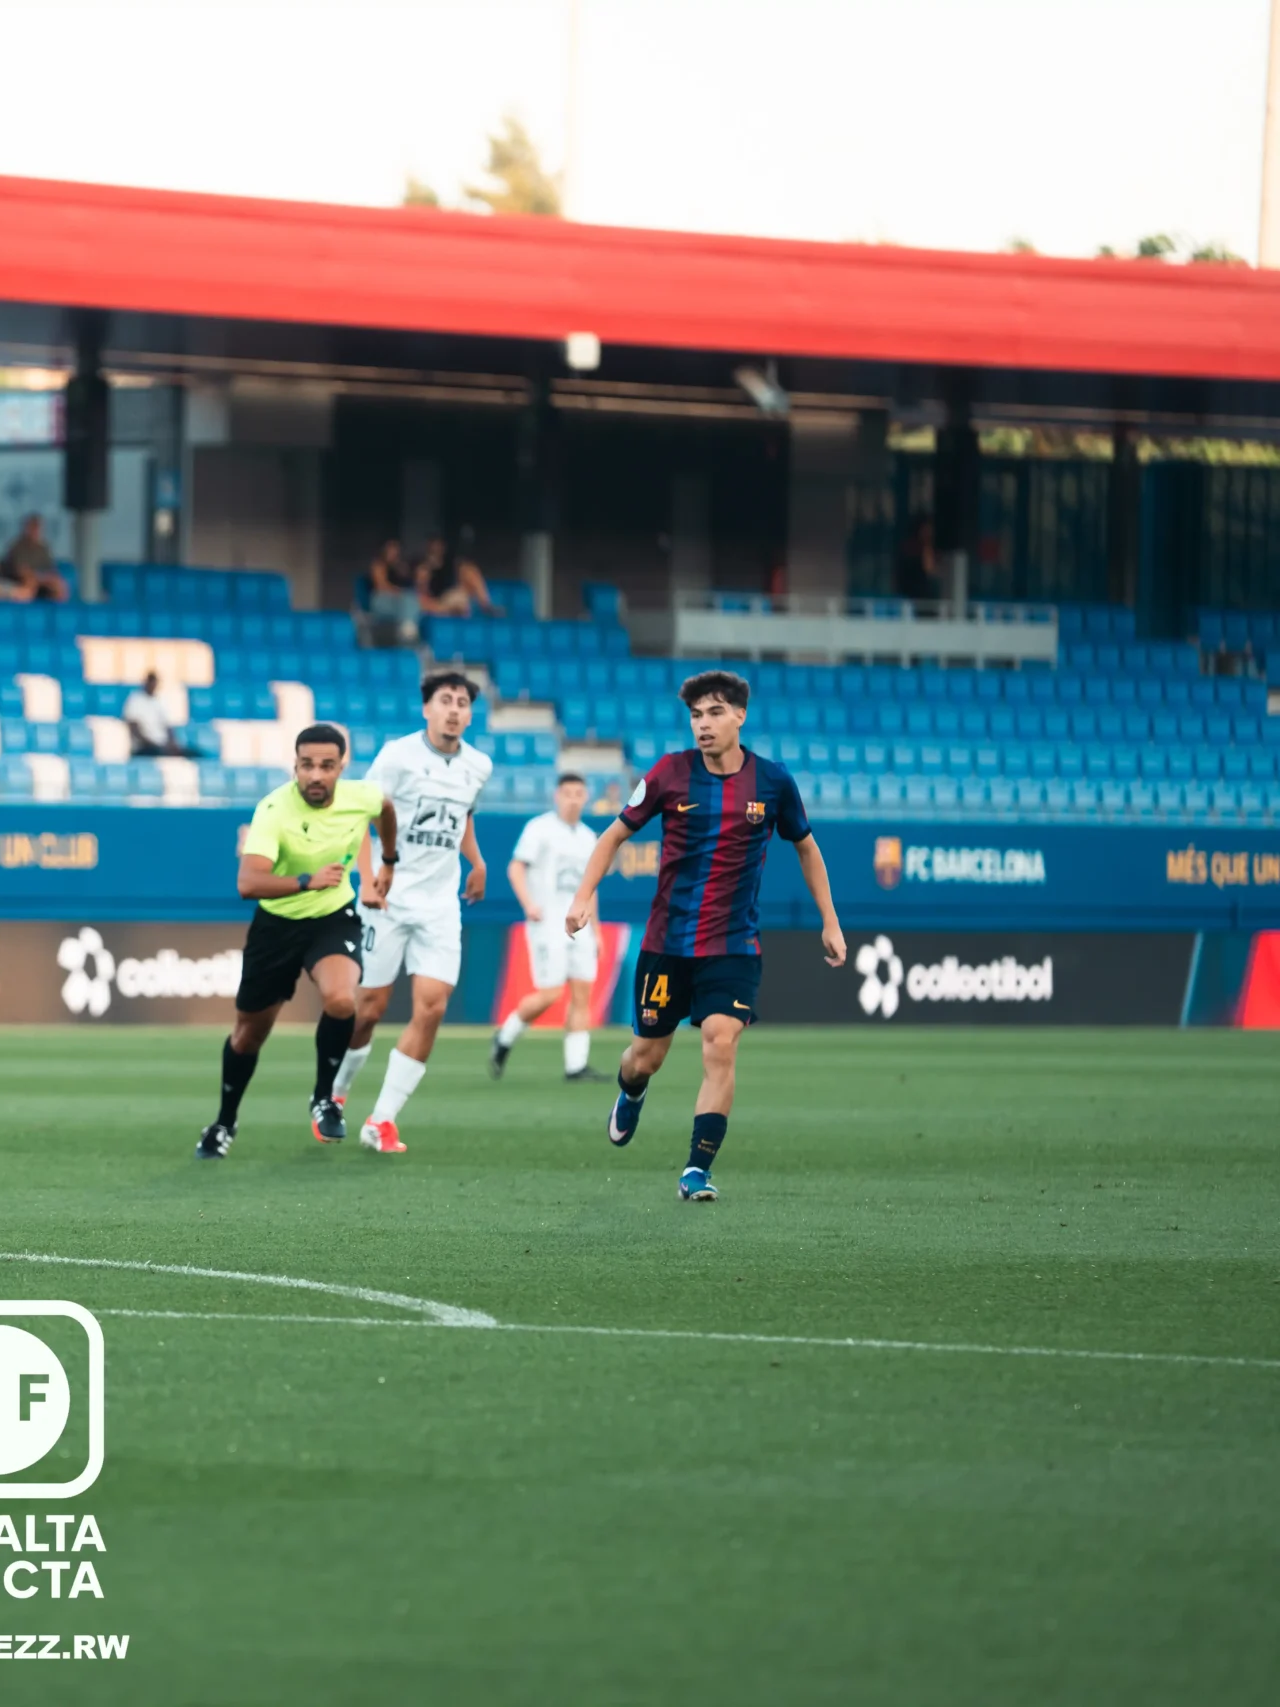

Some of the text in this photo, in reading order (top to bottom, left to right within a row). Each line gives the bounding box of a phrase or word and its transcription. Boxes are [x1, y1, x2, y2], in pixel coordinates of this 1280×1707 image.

[906, 846, 1046, 886] FC BARCELONA
[1167, 842, 1207, 884] MÉS
[1211, 850, 1249, 891] QUE
[640, 973, 671, 1008] 14
